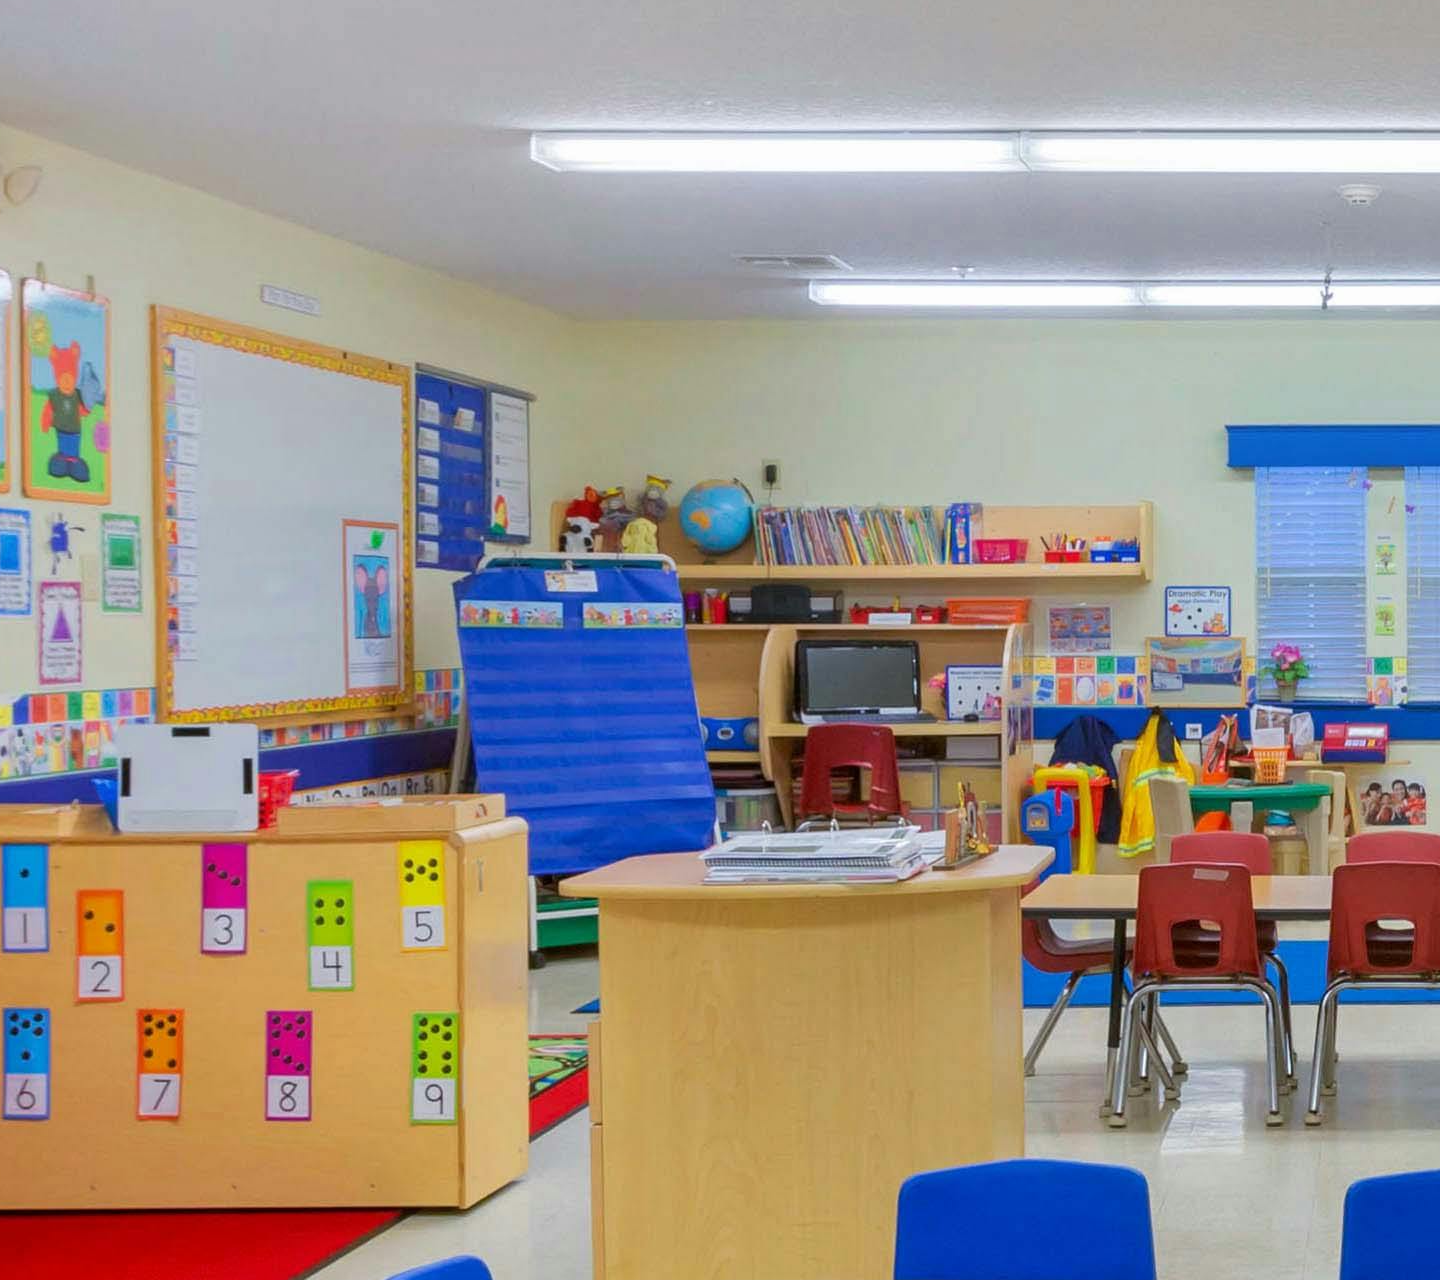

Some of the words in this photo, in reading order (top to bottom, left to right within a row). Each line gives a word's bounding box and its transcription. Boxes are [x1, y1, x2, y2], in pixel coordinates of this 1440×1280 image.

[1168, 590, 1207, 598] Dramatic
[1209, 590, 1227, 599] Play
[22, 912, 29, 944] 1
[213, 914, 234, 945] 3
[413, 911, 433, 943] 5
[91, 960, 111, 993] 2
[322, 951, 343, 982] 4
[16, 1079, 36, 1110] 6
[153, 1079, 172, 1111] 7
[279, 1081, 298, 1112] 8
[425, 1083, 444, 1115] 9
